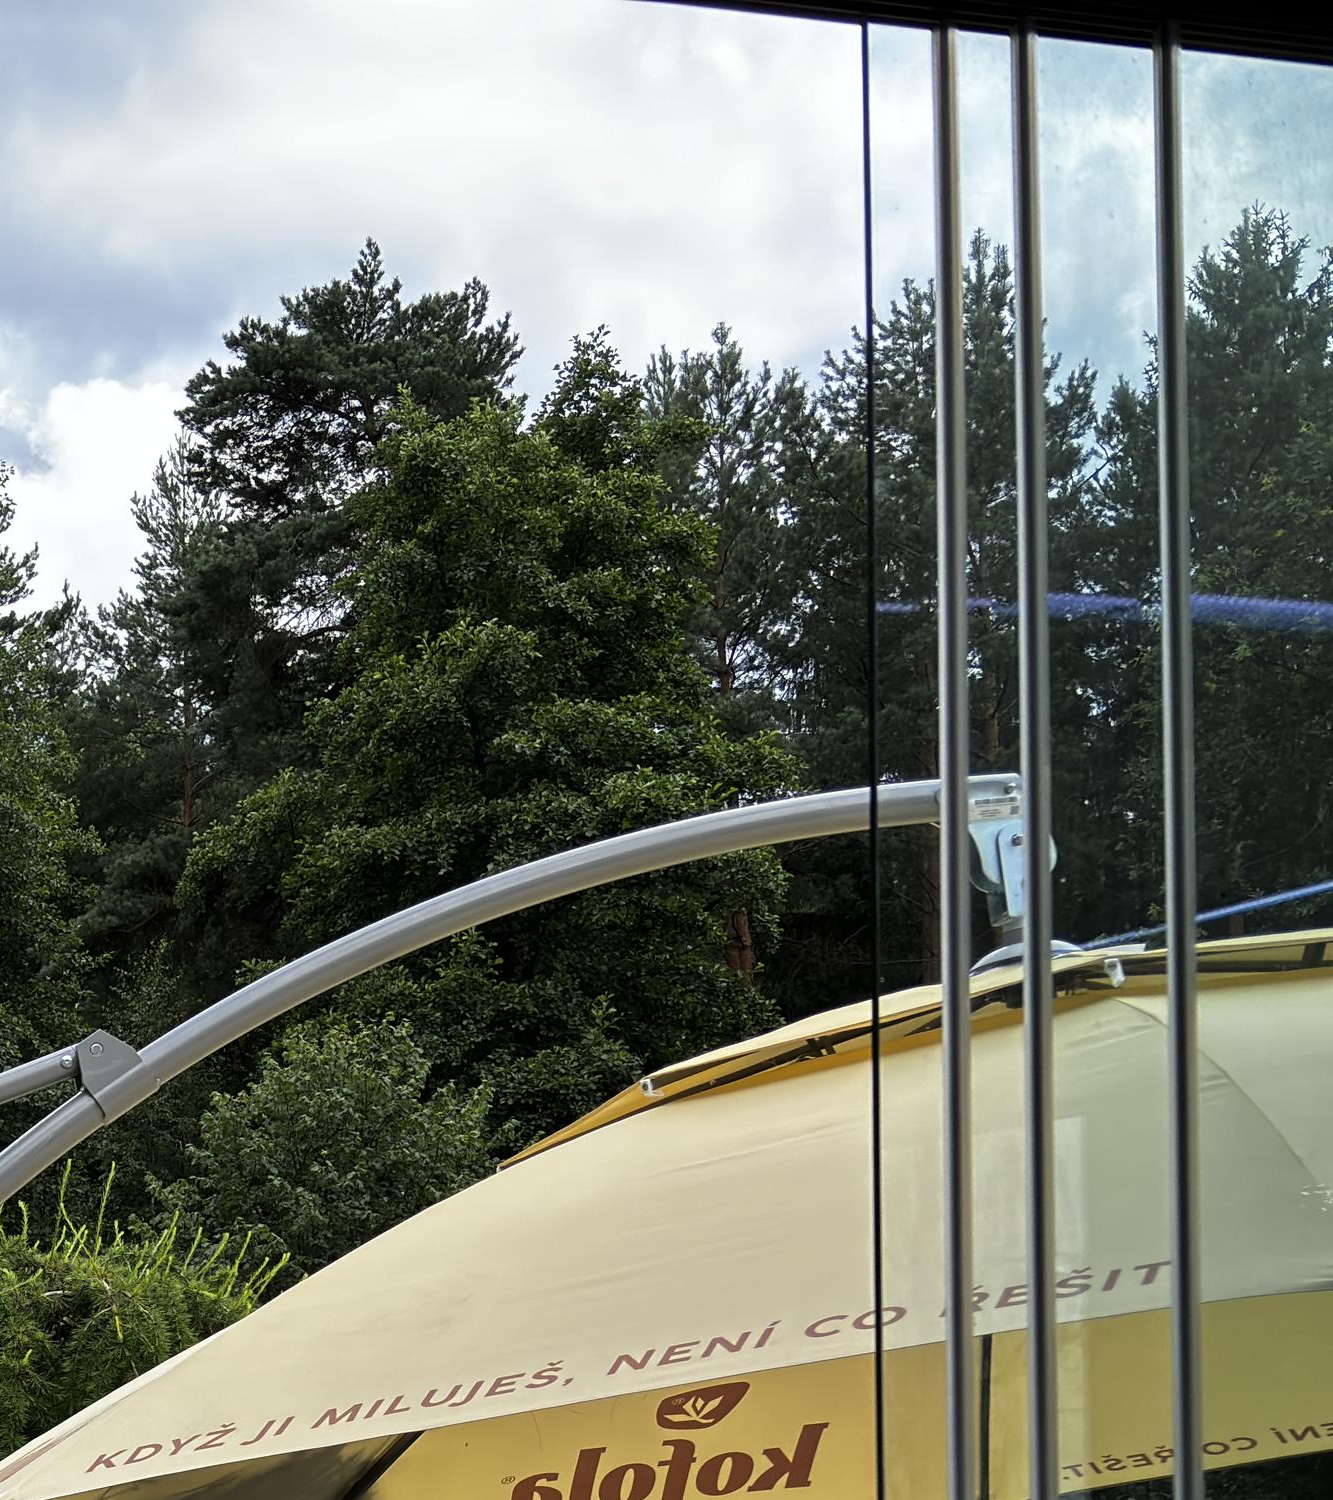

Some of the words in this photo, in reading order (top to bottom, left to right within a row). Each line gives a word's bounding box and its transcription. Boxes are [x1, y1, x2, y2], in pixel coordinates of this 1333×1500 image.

[85, 1421, 237, 1474] KDYŽ
[240, 1415, 295, 1446] JI
[310, 1359, 574, 1430] MILUJEŠ,
[606, 1319, 781, 1376] NENÍ
[804, 1305, 907, 1339] CO
